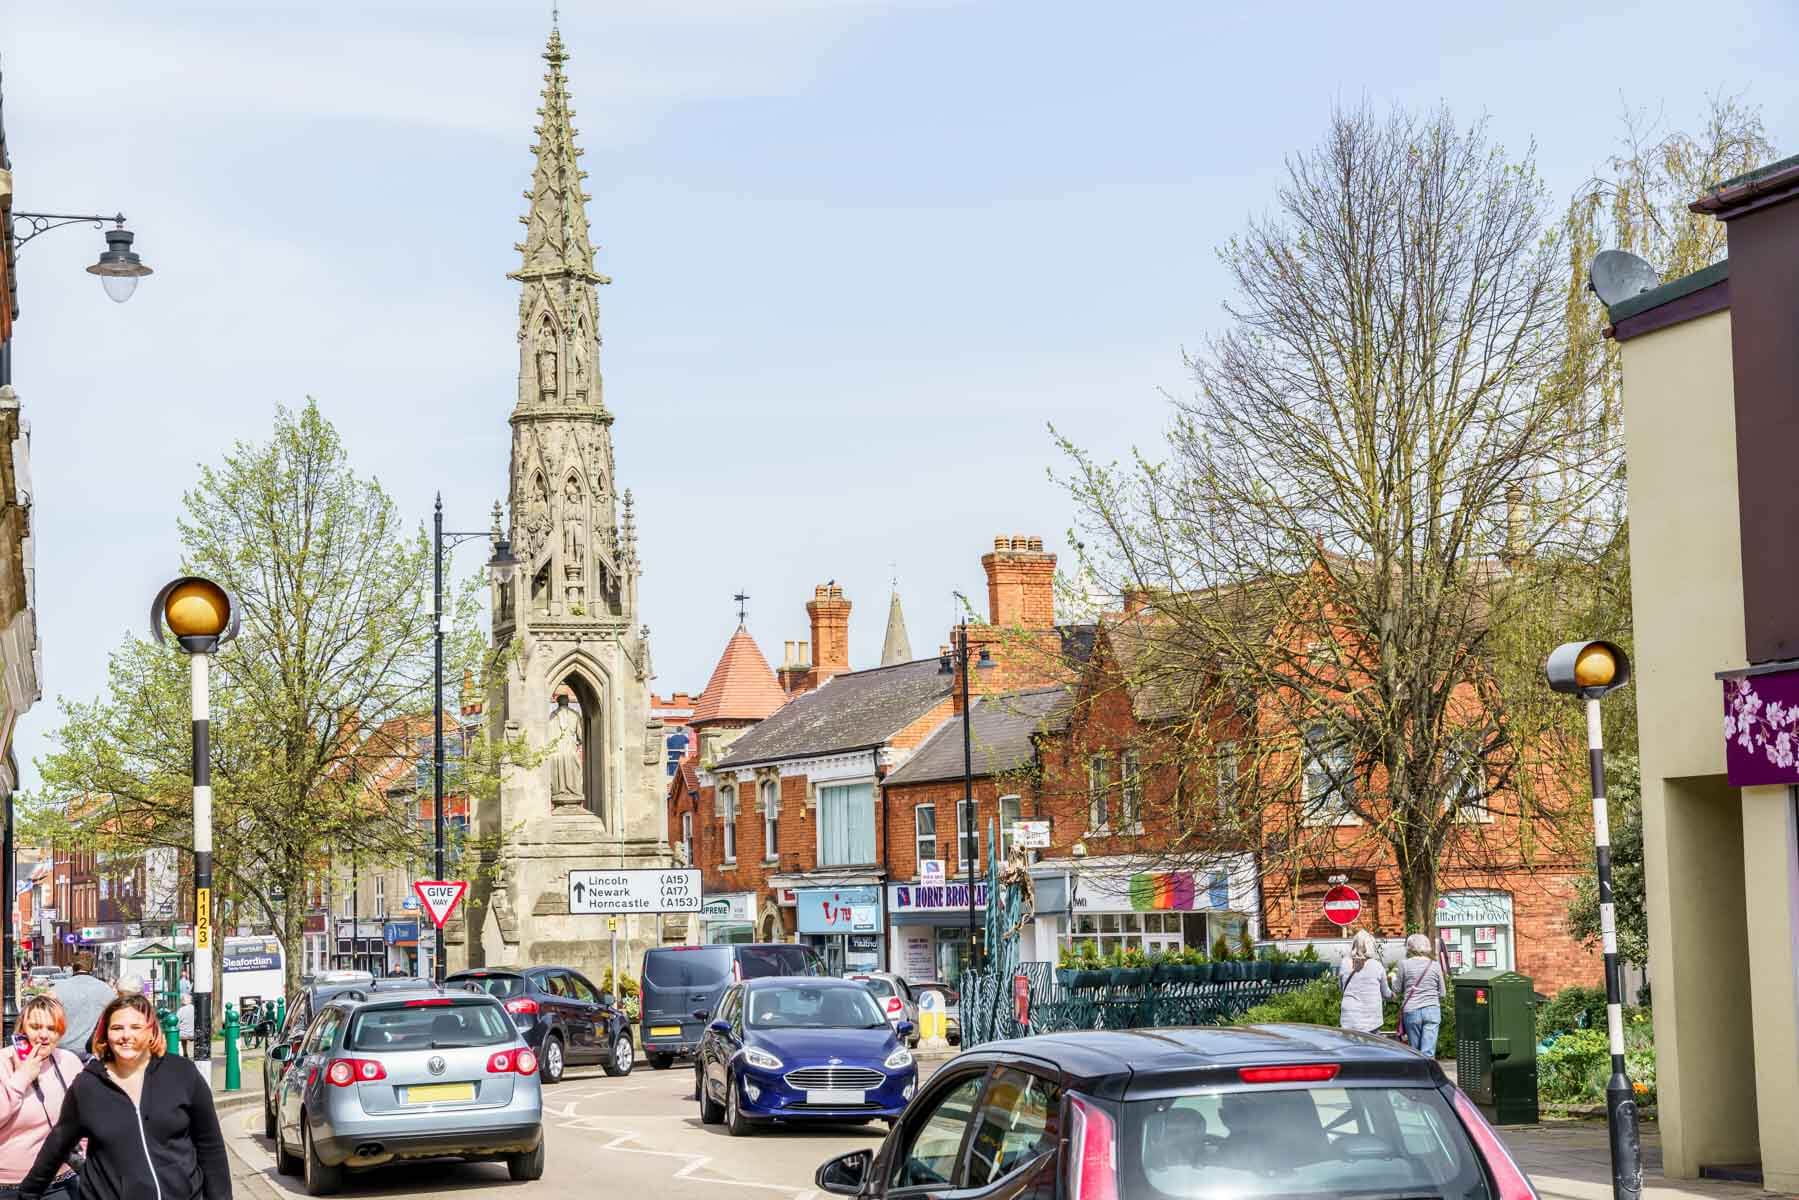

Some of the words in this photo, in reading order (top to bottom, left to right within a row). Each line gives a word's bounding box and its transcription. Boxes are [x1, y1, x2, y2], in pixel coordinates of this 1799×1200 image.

[588, 876, 628, 885] Lincoln
[660, 874, 689, 885] (A15)
[427, 887, 454, 897] GIVE
[589, 887, 630, 897] Newark
[660, 886, 688, 896] (A17)
[915, 886, 943, 907] HORNE
[945, 885, 969, 906] BROS
[432, 898, 448, 906] WAY
[589, 898, 650, 908] Horncastle
[660, 897, 698, 908] (A153)
[702, 906, 728, 915] UPREME
[608, 919, 616, 929] H
[223, 956, 272, 968] Sleafordian
